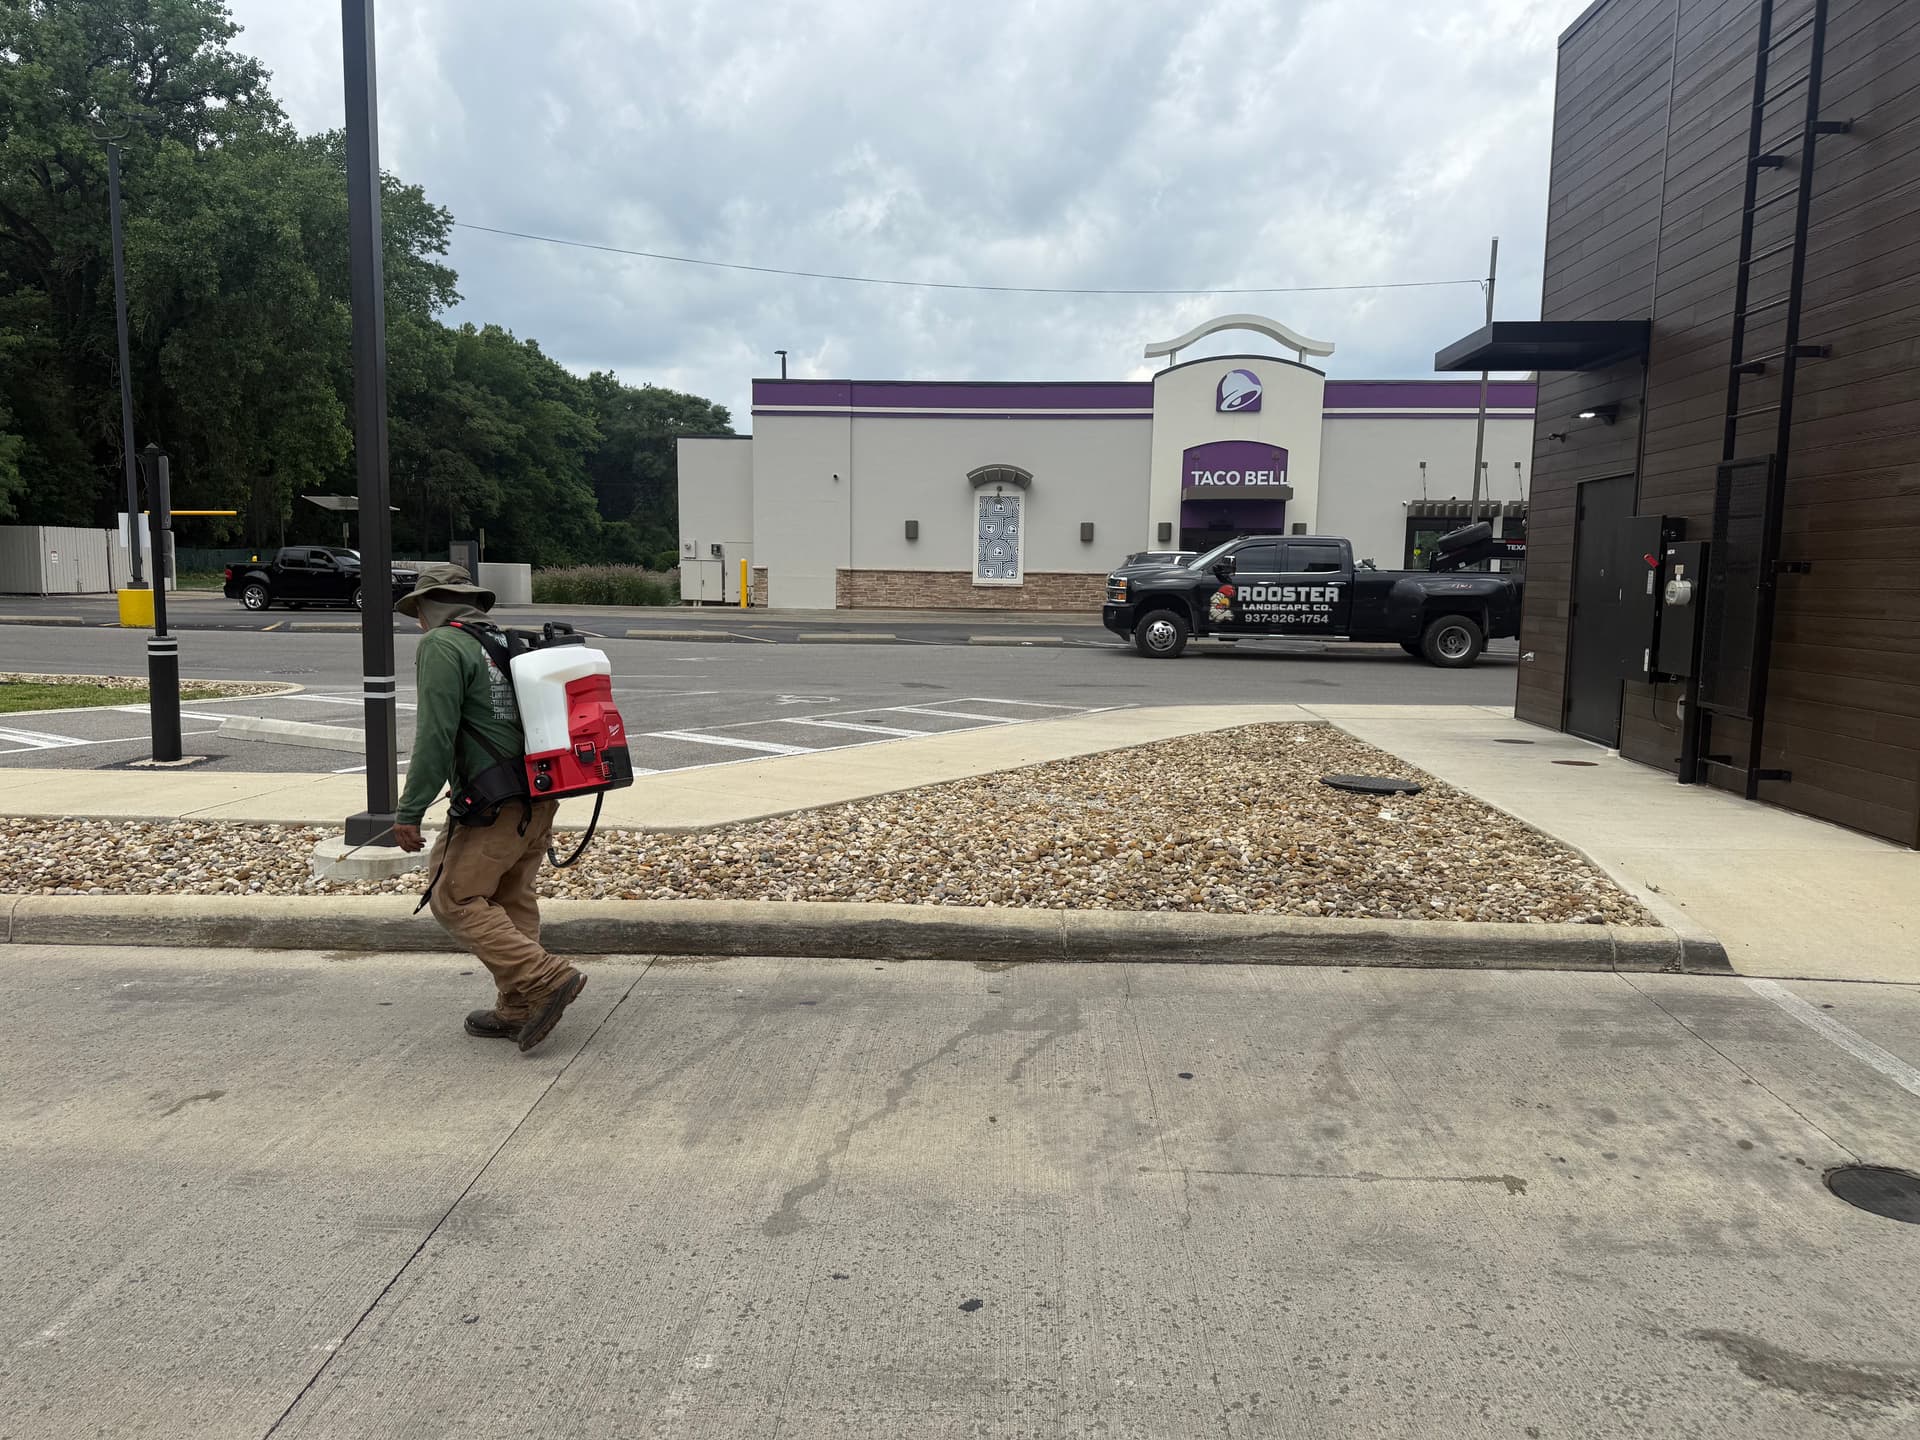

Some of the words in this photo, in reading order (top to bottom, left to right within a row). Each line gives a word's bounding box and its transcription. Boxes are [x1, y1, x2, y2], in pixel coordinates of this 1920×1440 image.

[1191, 470, 1241, 486] TACO
[1244, 470, 1290, 486] BELL
[1237, 586, 1340, 602] ROOSTER
[1242, 603, 1311, 612] LANDSCAPE
[1312, 604, 1333, 612] CO.
[1244, 613, 1329, 624] 937-926-1754
